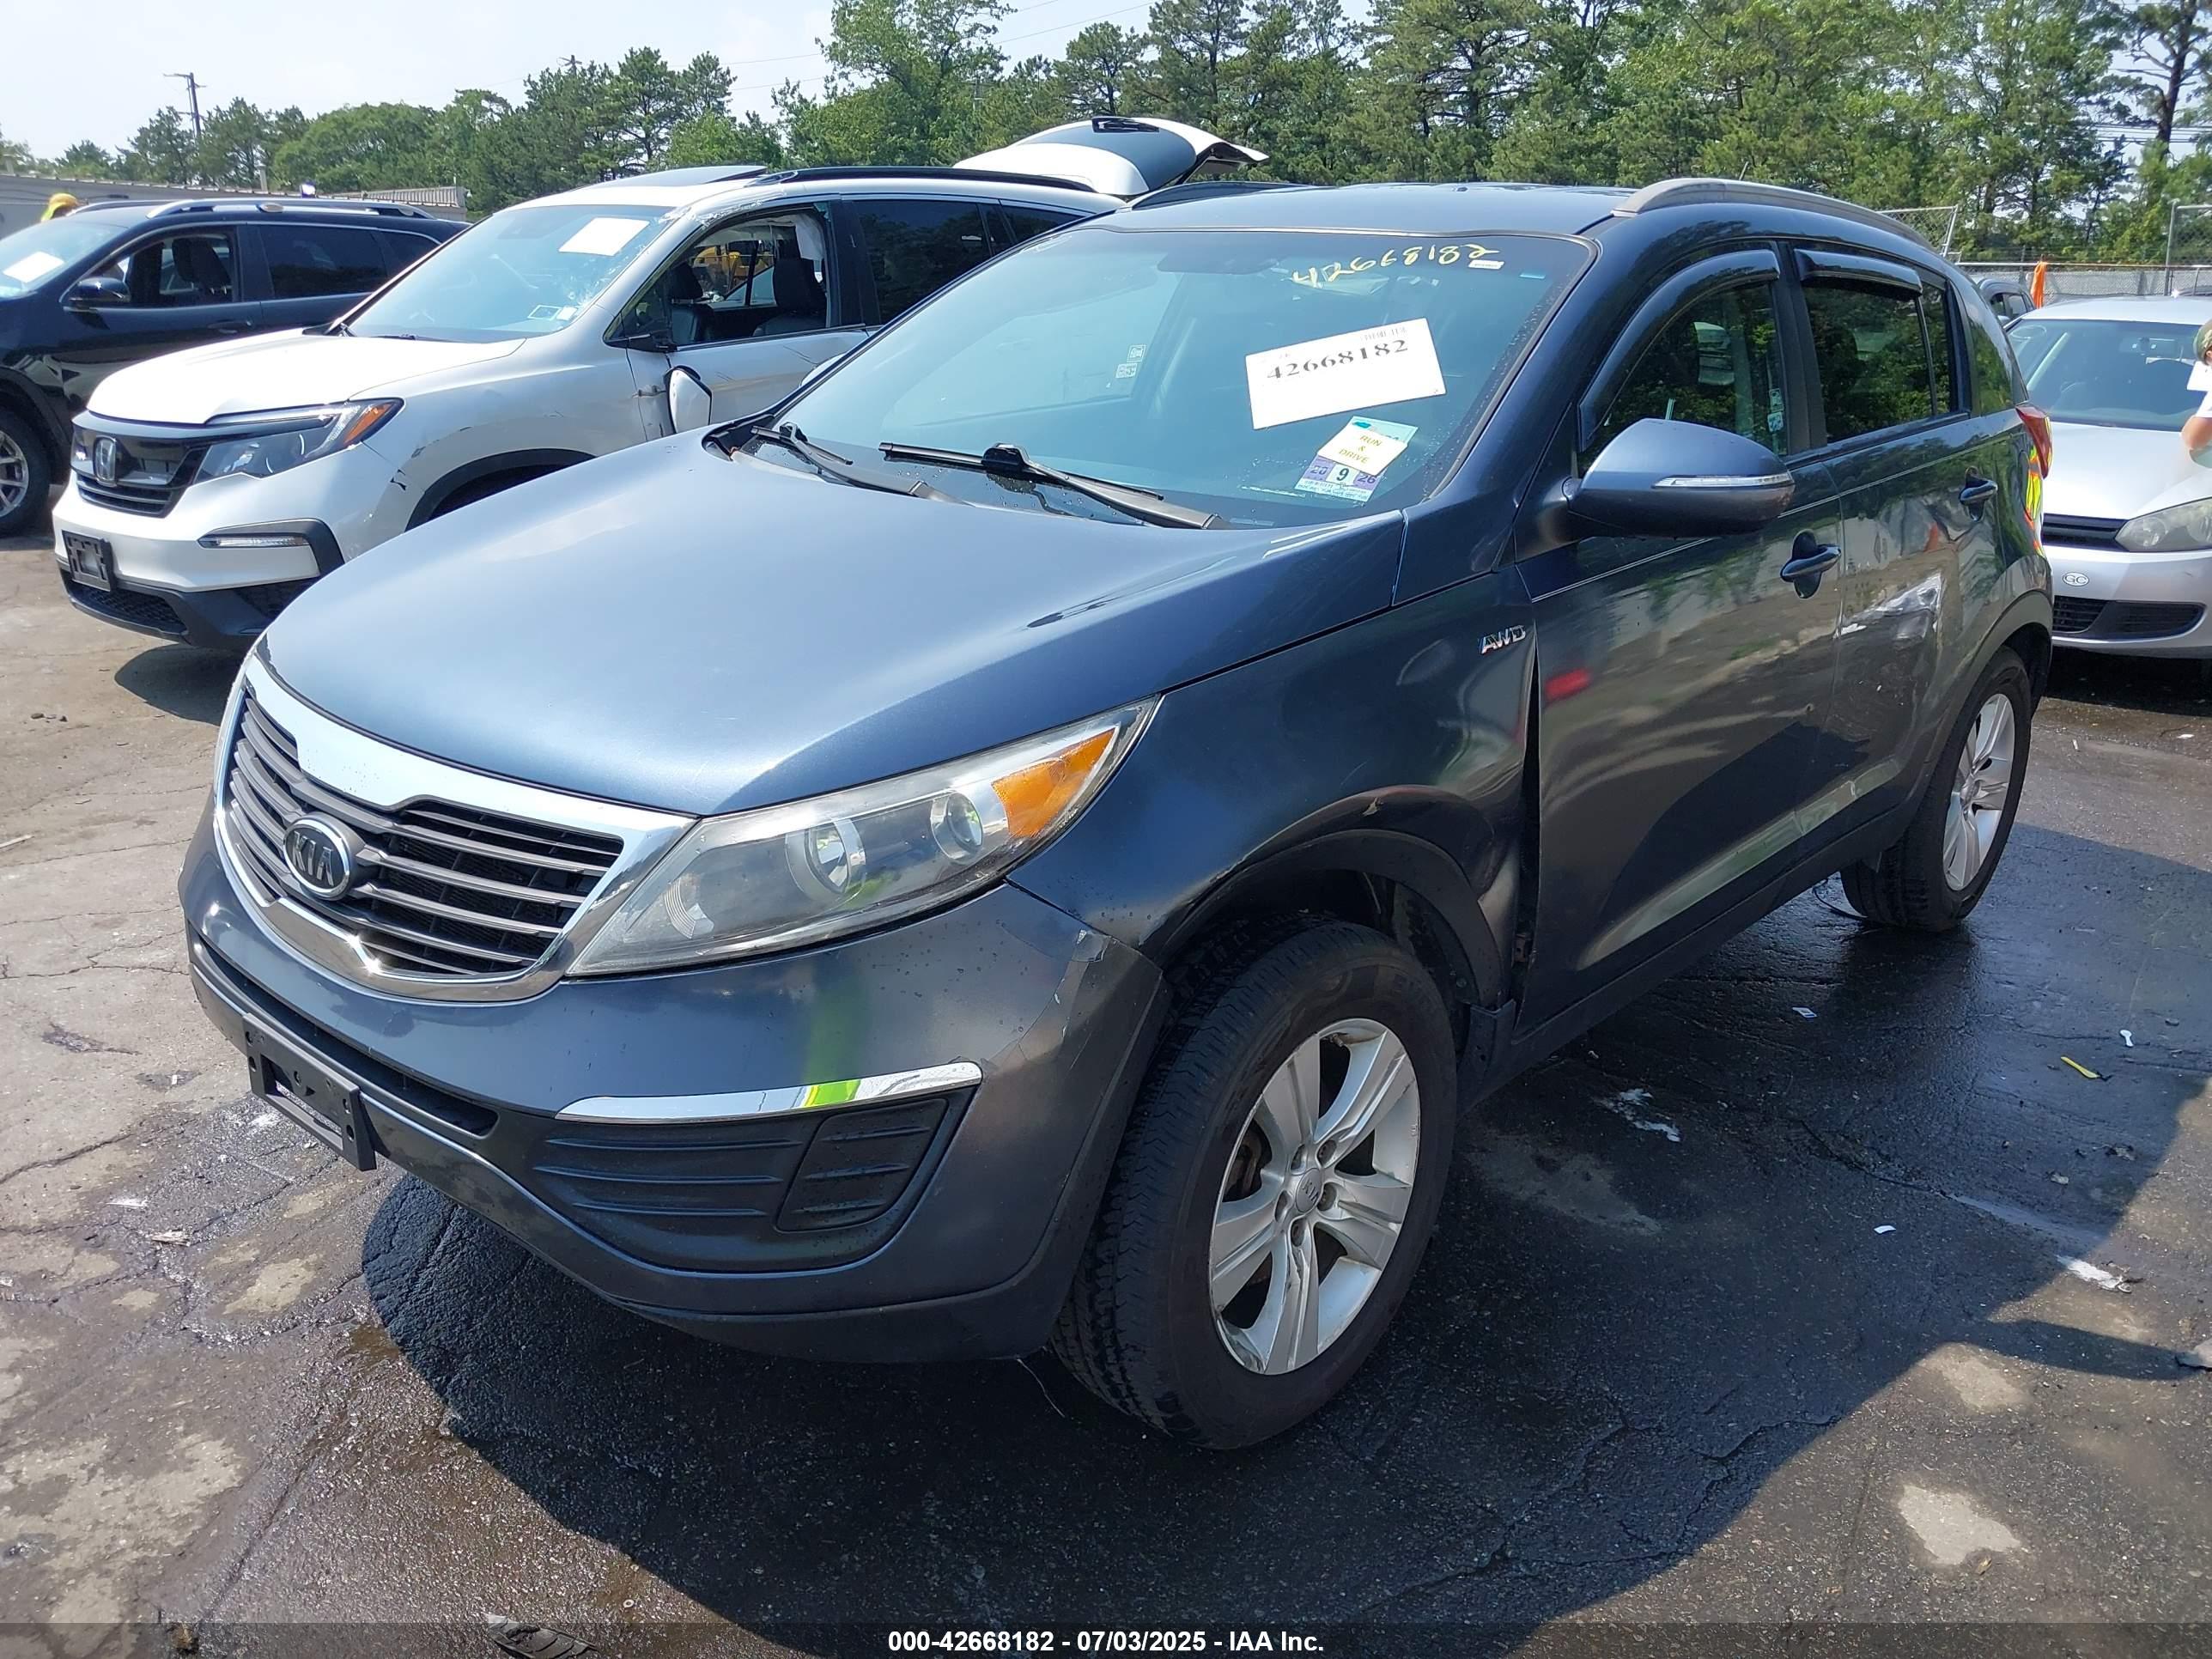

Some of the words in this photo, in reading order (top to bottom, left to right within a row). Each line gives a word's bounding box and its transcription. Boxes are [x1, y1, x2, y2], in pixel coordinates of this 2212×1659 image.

[1290, 244, 1500, 289] 42668182
[1267, 339, 1409, 379] 42668182
[1360, 434, 1382, 447] RUN
[1340, 449, 1370, 464] DRIVE
[1336, 467, 1349, 481] 9
[1357, 475, 1376, 484] 26
[1479, 624, 1526, 654] AWD
